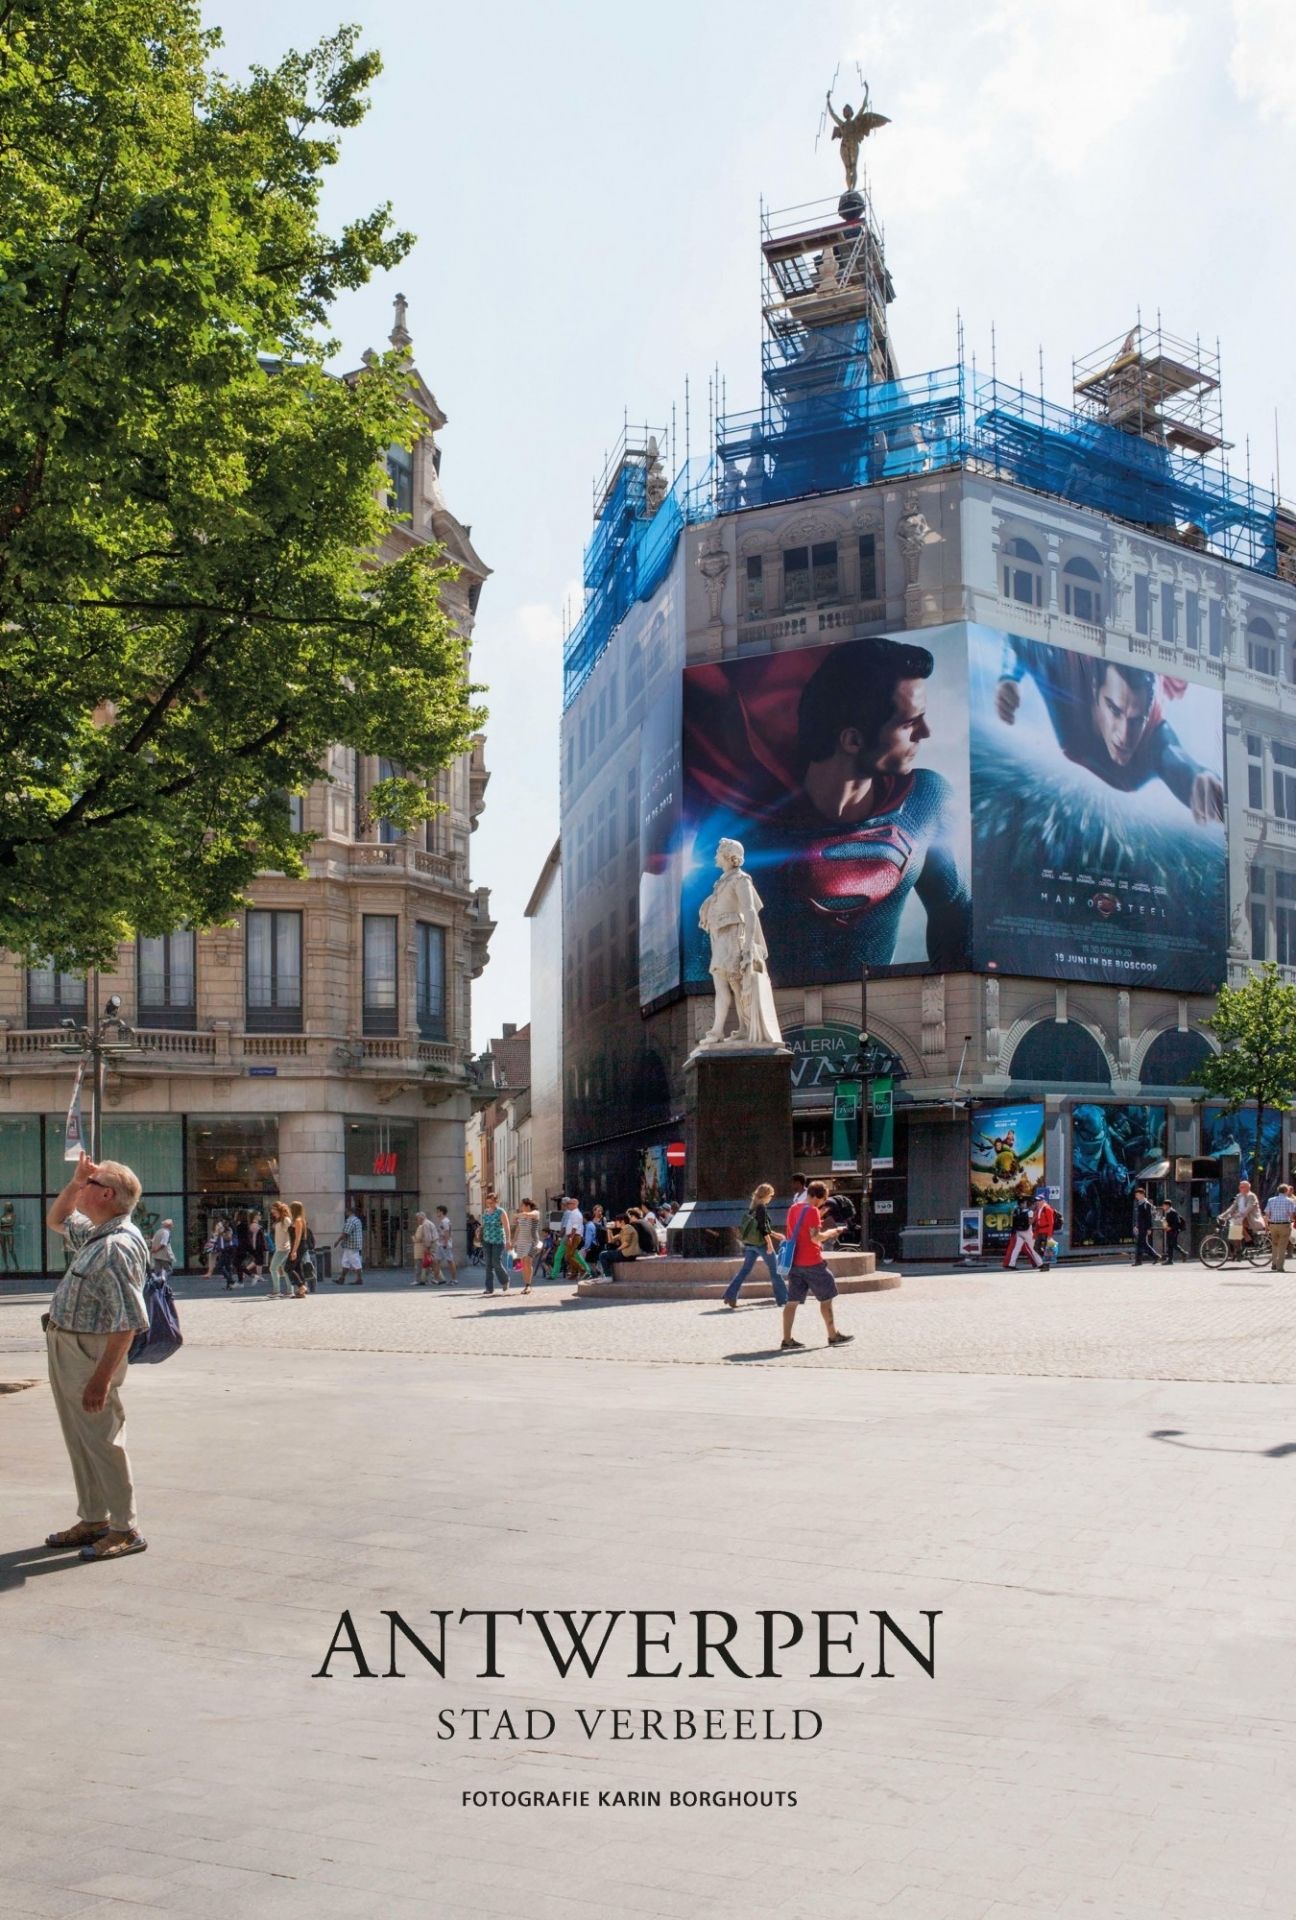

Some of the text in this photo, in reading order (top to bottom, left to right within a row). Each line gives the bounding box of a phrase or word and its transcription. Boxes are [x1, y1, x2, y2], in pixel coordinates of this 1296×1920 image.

[1041, 892, 1166, 918] MAN OF STEEL
[1055, 953, 1158, 971] 19 JUNI IN DE BIOSCOOP
[785, 1038, 846, 1053] GALERIA
